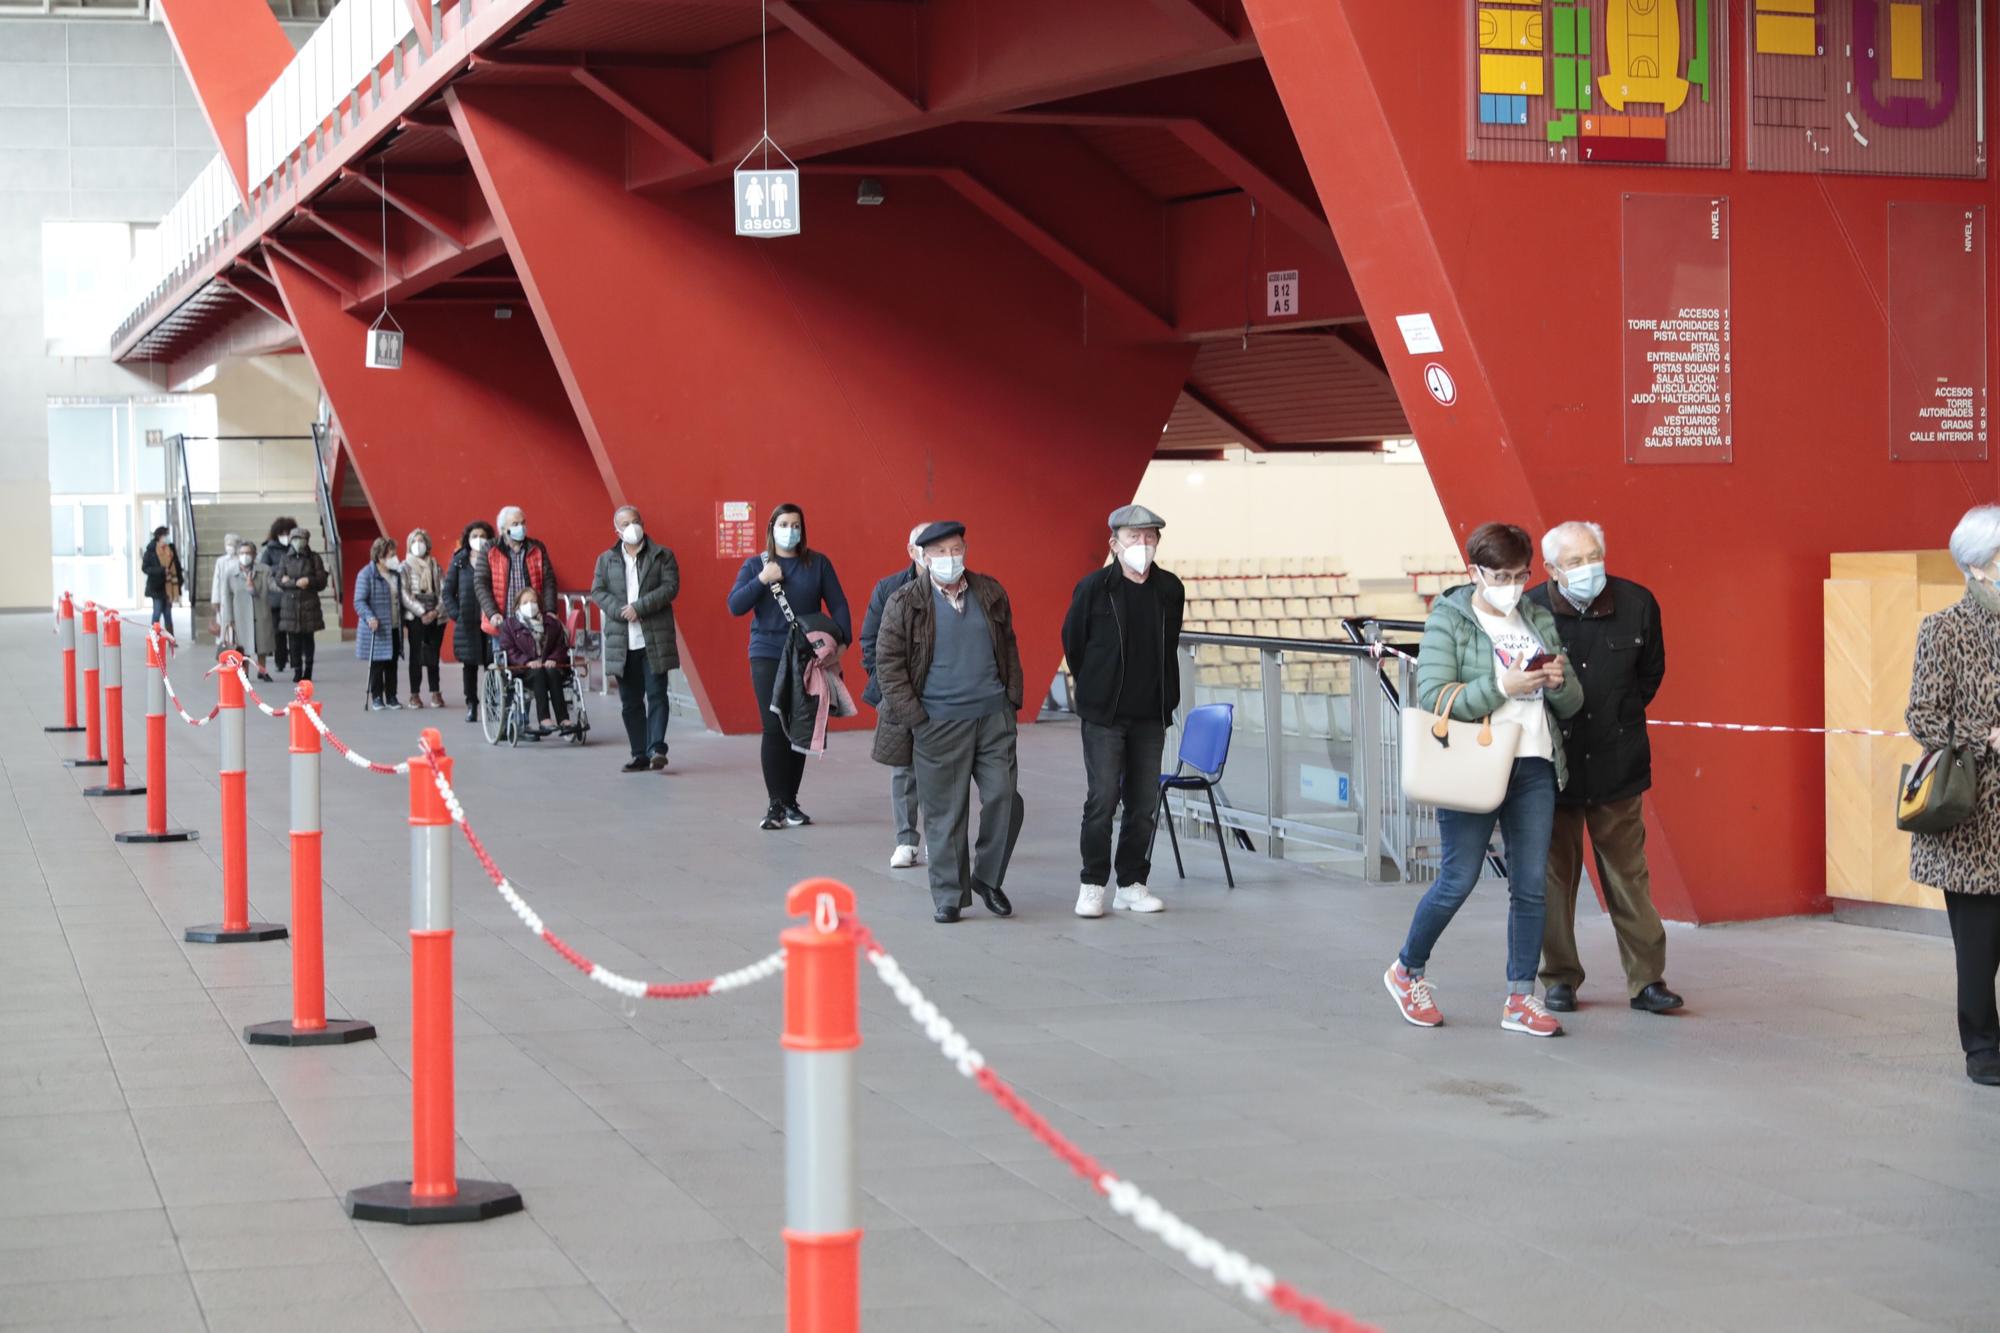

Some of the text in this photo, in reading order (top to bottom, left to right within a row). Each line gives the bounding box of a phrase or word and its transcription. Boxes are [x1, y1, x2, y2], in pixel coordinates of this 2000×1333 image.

[1520, 37, 1527, 46] 4
[1818, 46, 1824, 56] 9
[1868, 48, 1874, 58] 9
[1520, 82, 1527, 91] 4
[1585, 86, 1591, 95] 8
[1622, 86, 1628, 95] 3
[1520, 113, 1527, 123] 5
[1585, 120, 1592, 130] 6
[1813, 141, 1817, 151] 1
[1550, 147, 1554, 157] 1
[1586, 148, 1592, 159] 7
[744, 217, 792, 230] aseos
[1711, 207, 1720, 240] NIVEL
[1964, 211, 1973, 252] NIVEL 2
[1274, 284, 1289, 297] B 12
[1274, 300, 1290, 313] A 5
[1678, 308, 1728, 318] ACCESOS 1
[1628, 319, 1729, 331] TORRE AUTORIDADES 2
[1654, 331, 1729, 342] PISTA CENTRAL 3
[1691, 343, 1719, 352] PISTAS
[1647, 352, 1730, 362] ENTRENAMIENTO 4
[1653, 363, 1730, 373] PISTAS SQUASH 5
[1656, 374, 1684, 383] SALAS
[1935, 387, 1986, 397] ACCESOS 1
[1631, 394, 1656, 404] JUDO
[1661, 394, 1720, 404] HALTEROFILIA
[1724, 393, 1730, 402] 6
[1946, 398, 1973, 408] TORRE
[1678, 404, 1730, 415] GIMNASIO 7
[1919, 408, 1986, 418] AUTORIDADES 2
[1941, 420, 1986, 430] GRADAS 9
[1644, 436, 1731, 448] SALAS RAYOS UVA 8
[1909, 432, 1987, 442] CALLE INTERIOR 10
